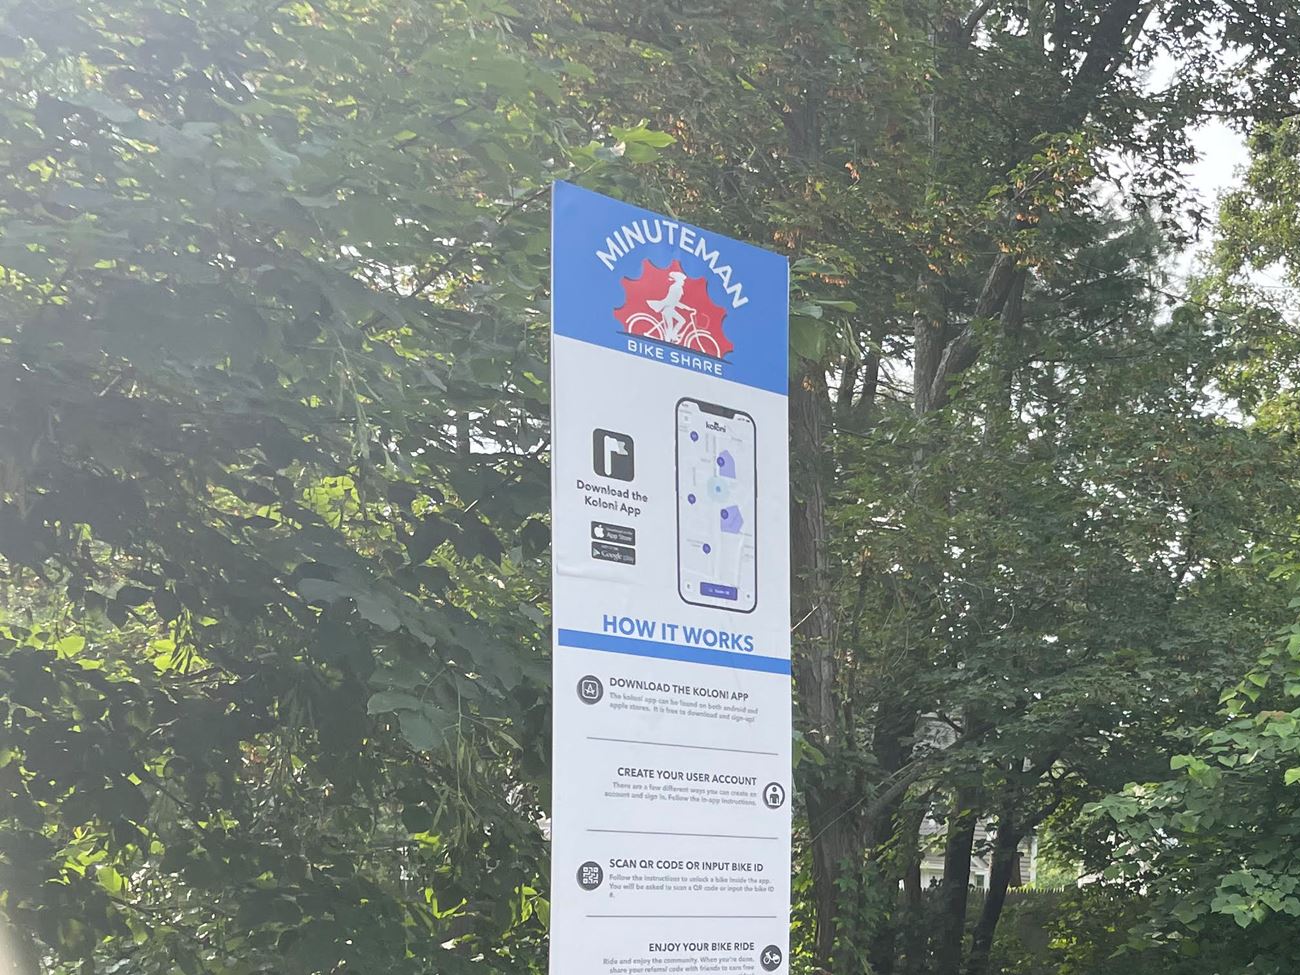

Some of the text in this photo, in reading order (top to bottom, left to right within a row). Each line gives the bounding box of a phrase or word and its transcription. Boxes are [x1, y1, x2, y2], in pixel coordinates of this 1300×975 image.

[596, 219, 749, 308] MINUTEMAN
[627, 340, 722, 376] BIKE SHARE
[577, 480, 648, 502] Download the
[585, 496, 640, 517] Koloni App
[603, 614, 754, 652] HOW IT WORKS
[610, 678, 749, 701] DOWNLOAD THE KOLONI APP
[618, 767, 757, 785] CREATE YOUR USER ACCOUNT
[609, 859, 636, 868] SCAN
[640, 860, 654, 869] QR
[656, 860, 684, 869] CODE
[686, 861, 699, 870] OR
[702, 862, 730, 871] INPUT
[732, 862, 751, 871] BIKE
[649, 942, 754, 952] ENJOY YOUR BIKE RIDE
